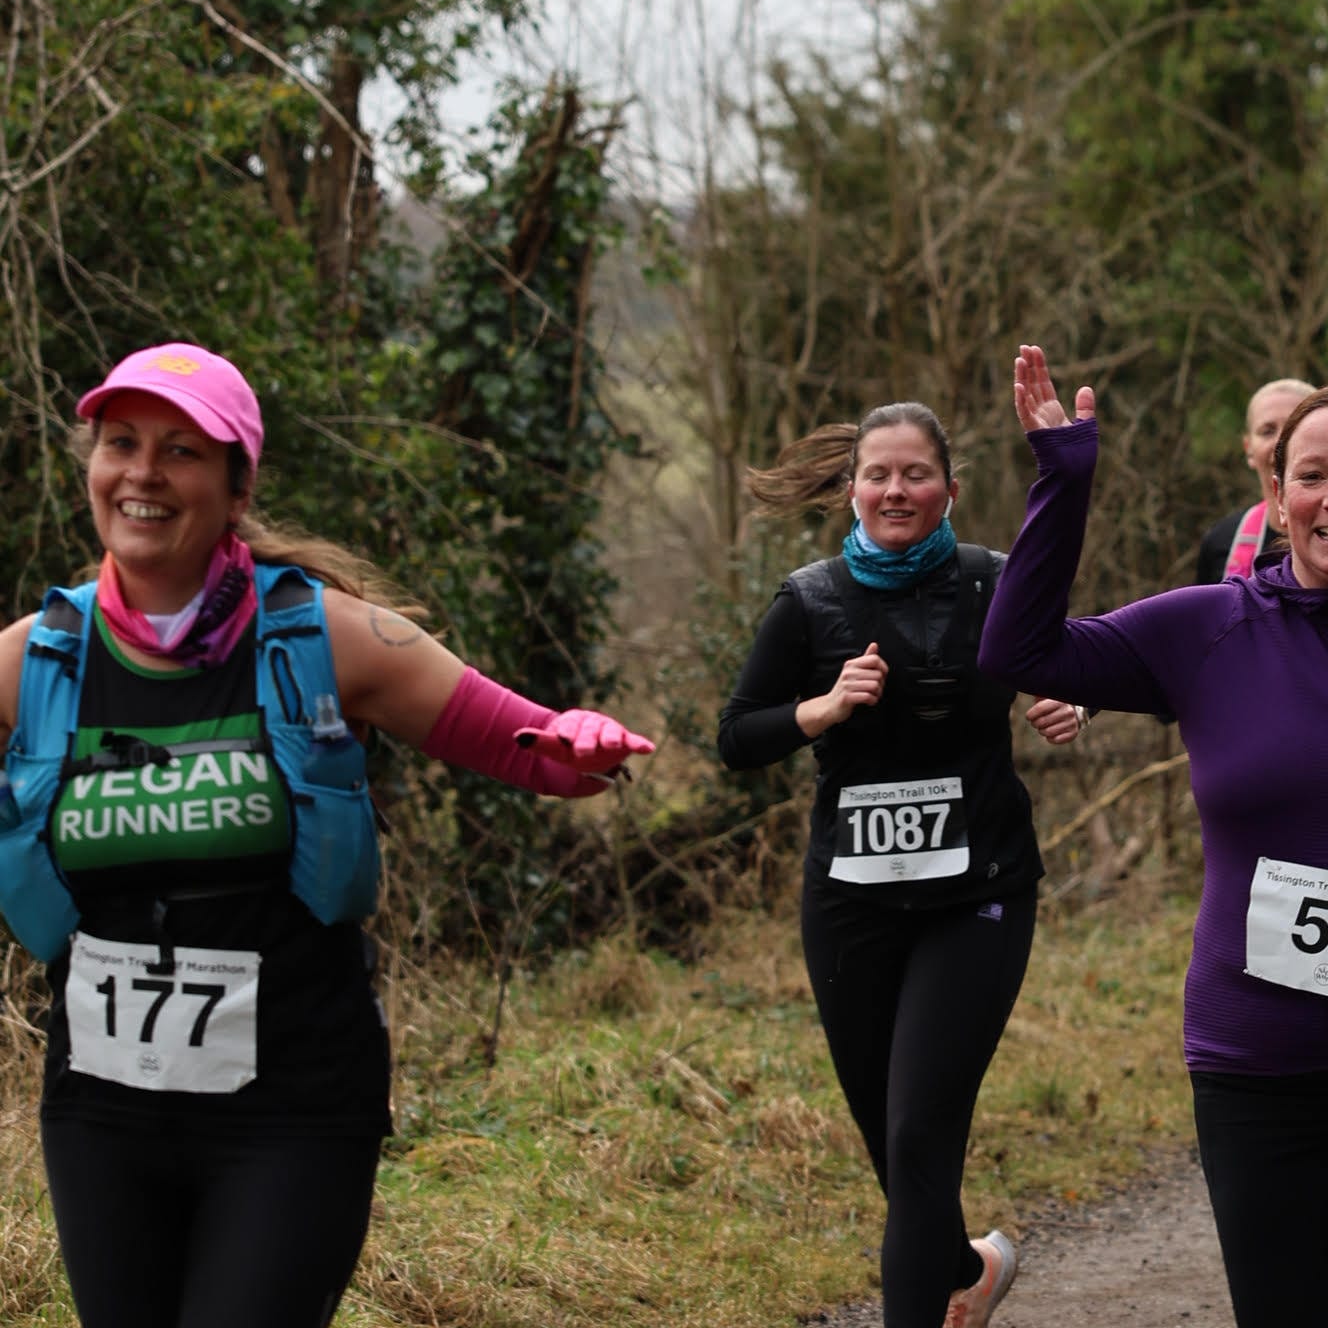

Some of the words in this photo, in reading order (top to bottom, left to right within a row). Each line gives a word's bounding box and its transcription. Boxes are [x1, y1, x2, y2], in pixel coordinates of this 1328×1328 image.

[73, 751, 269, 800] VEGAN
[898, 787, 925, 798] Trail
[927, 784, 948, 795] 10k
[60, 793, 272, 842] RUNNERS
[847, 803, 950, 854] 1087
[1266, 871, 1315, 888] Tissington
[186, 961, 247, 975] Marathon
[97, 975, 226, 1047] 177
